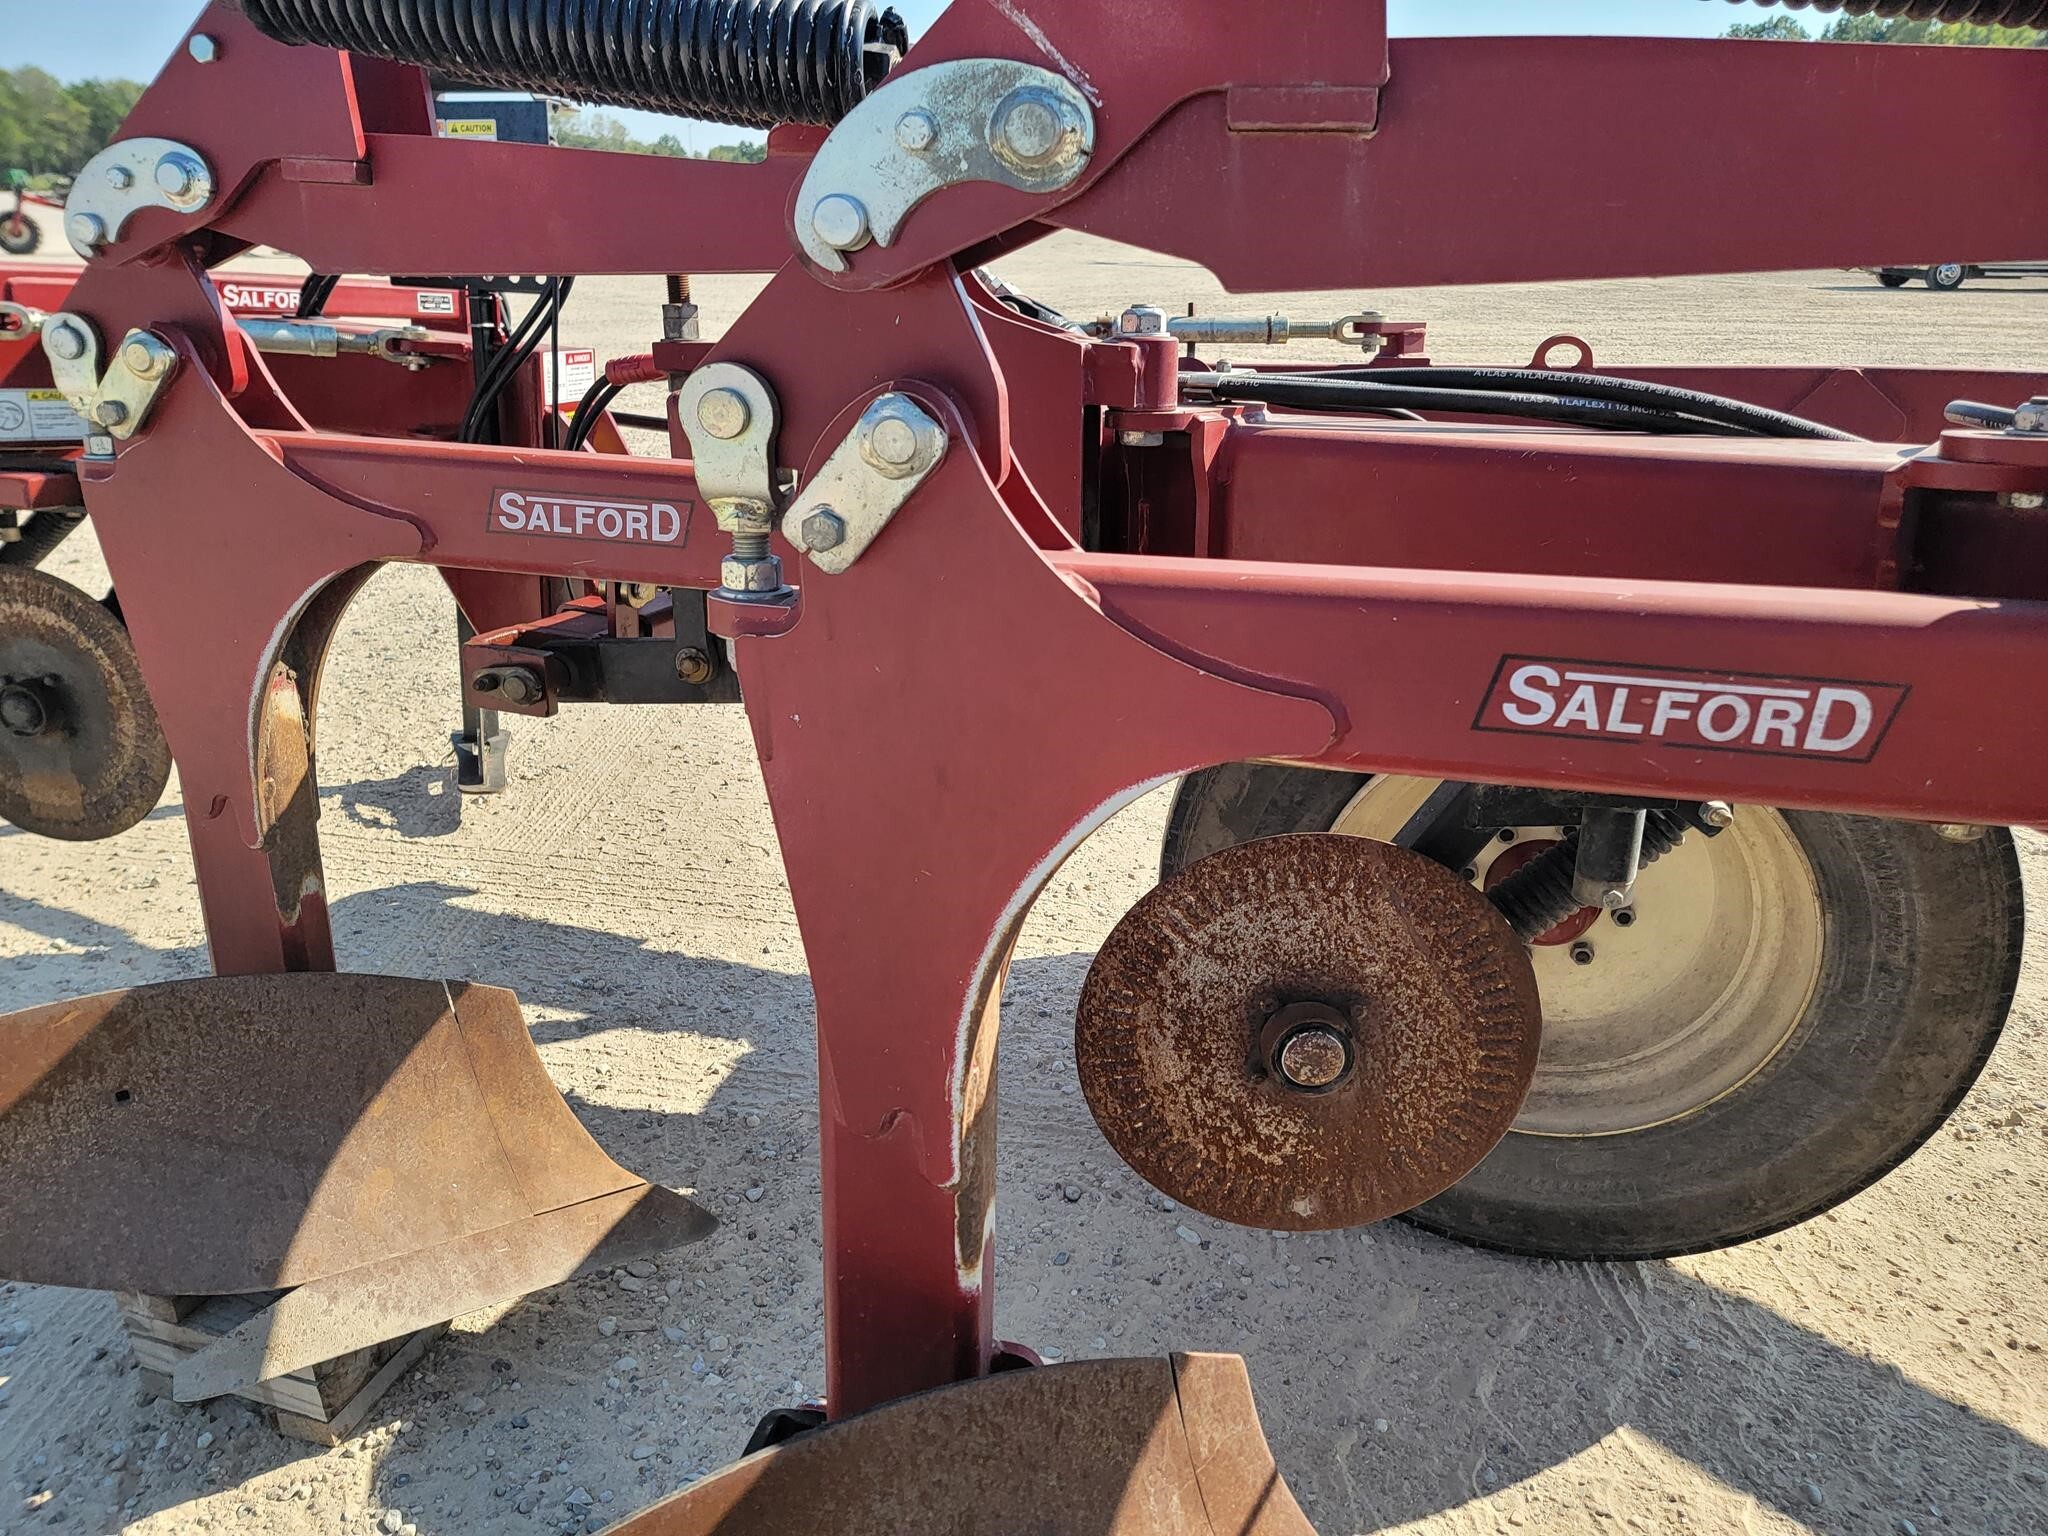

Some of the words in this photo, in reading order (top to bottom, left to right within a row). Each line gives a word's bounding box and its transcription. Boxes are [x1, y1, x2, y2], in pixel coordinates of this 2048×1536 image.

[460, 124, 492, 133] CAUTION
[223, 283, 301, 309] SALFOR
[1473, 369, 1508, 378] ATLAS
[1515, 371, 1570, 383] ATLAFLEX
[1577, 376, 1592, 385] 1/2
[1593, 377, 1621, 388] INCH
[1668, 388, 1693, 401] MAX
[1508, 394, 1544, 403] ATLAS
[1551, 398, 1606, 409] ATLAFLEX
[1615, 403, 1630, 412] 1/2
[498, 491, 681, 542] SALFORD
[1501, 664, 1873, 752] SALFORD
